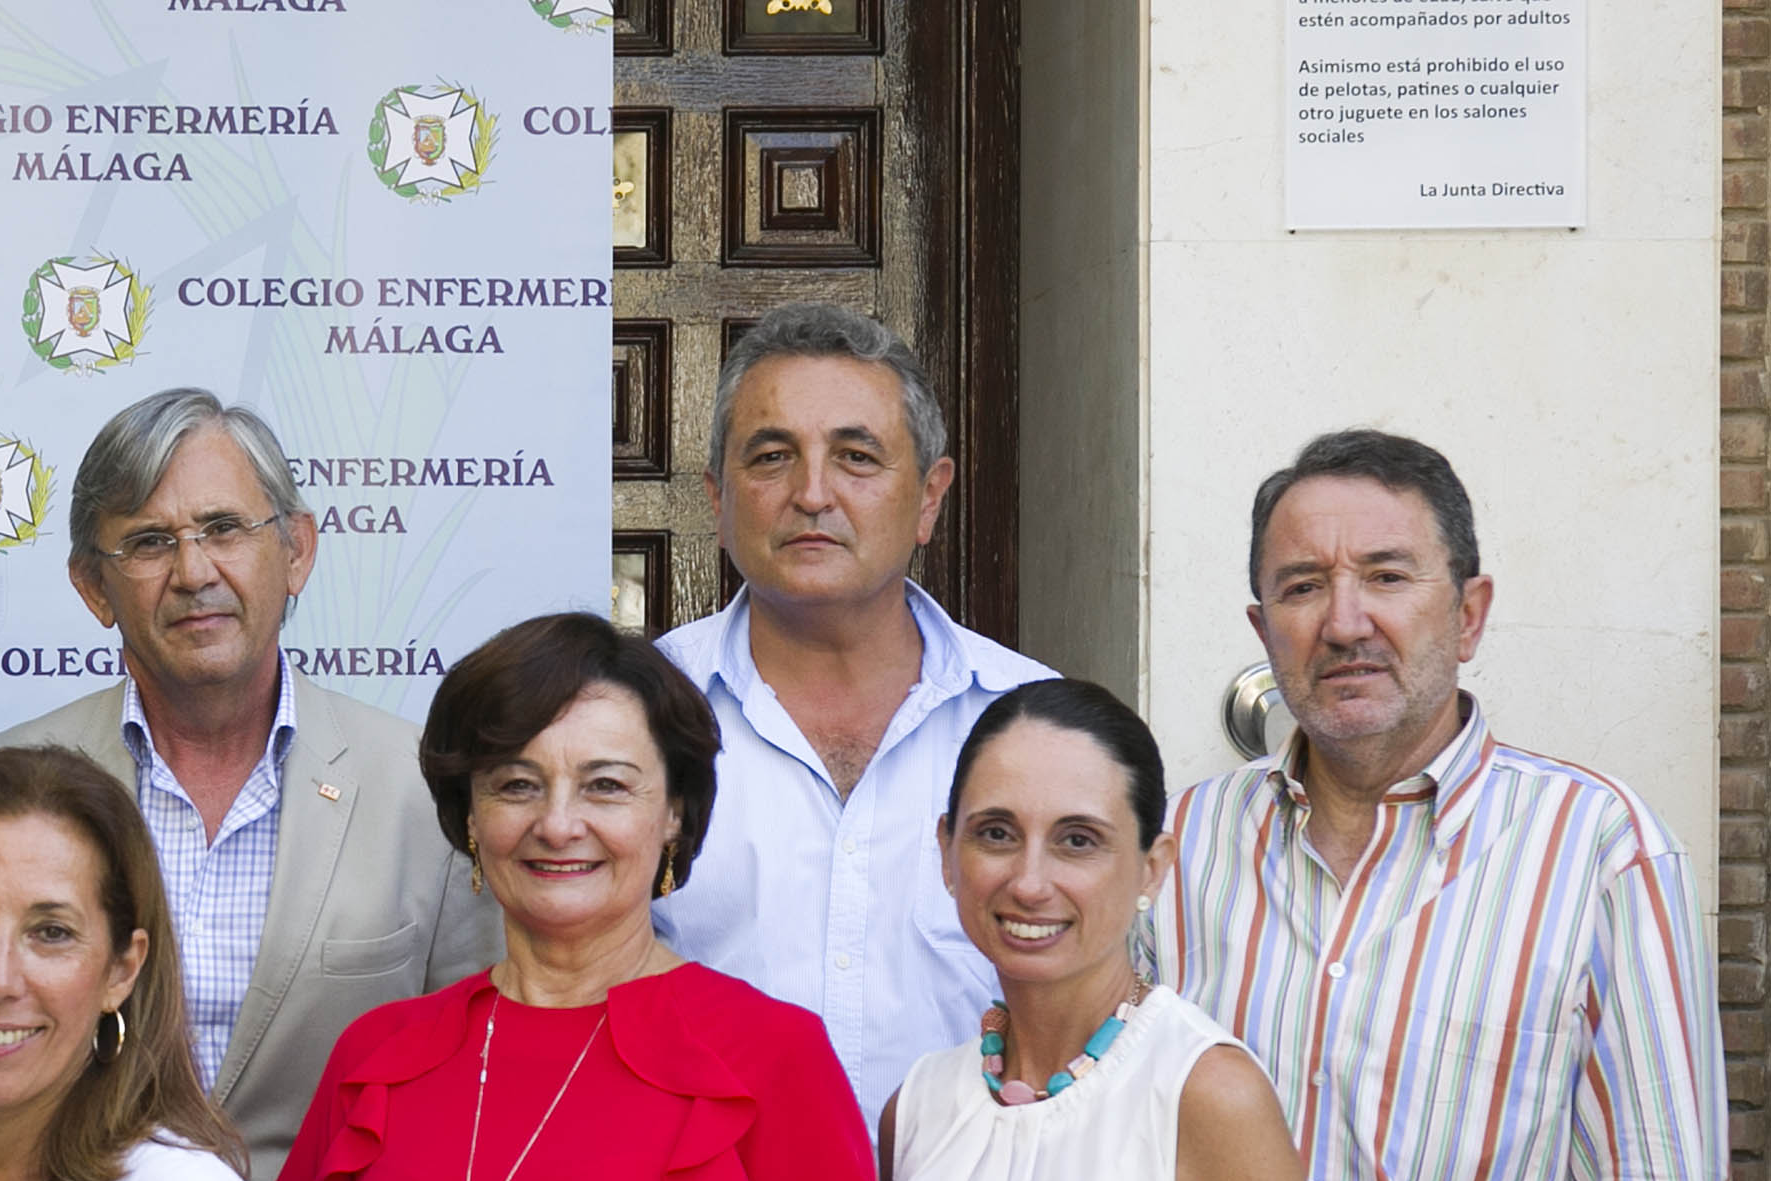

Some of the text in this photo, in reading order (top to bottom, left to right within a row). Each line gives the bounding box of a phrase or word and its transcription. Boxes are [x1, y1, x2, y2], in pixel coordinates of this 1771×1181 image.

[1298, 9, 1571, 29] estén acompañados por adultos
[1298, 56, 1565, 76] Asimismo está prohibido el uso
[1298, 80, 1560, 98] de pelotas, patines o cualquier
[65, 98, 340, 136] ENFERMERÍA
[523, 106, 612, 136] COL
[1298, 103, 1527, 123] otro juguete en los salones
[1298, 127, 1365, 144] sociales
[12, 145, 193, 183] MÁLAGA
[1420, 182, 1565, 197] La Junta Directiva
[177, 277, 612, 308] COLEGIO ENFERMER
[323, 320, 505, 355] MÁLAGA
